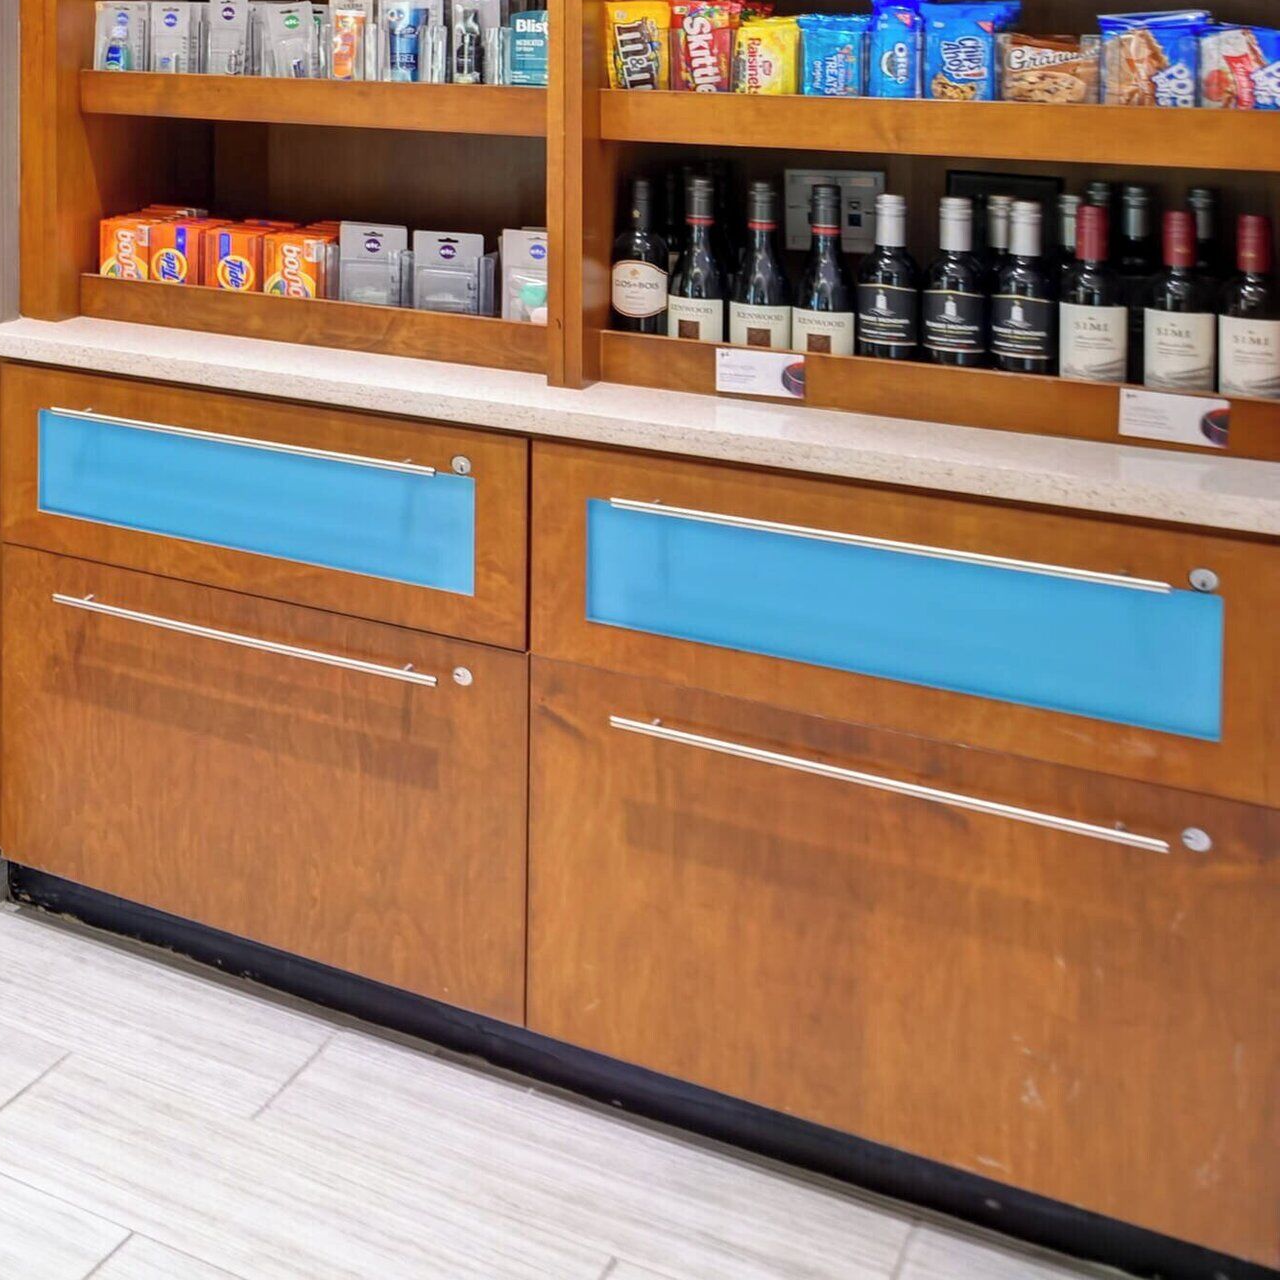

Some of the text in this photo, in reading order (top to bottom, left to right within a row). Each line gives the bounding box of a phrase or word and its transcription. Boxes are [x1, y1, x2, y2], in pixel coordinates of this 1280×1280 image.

[894, 42, 908, 84] OREO
[160, 252, 179, 281] Tide
[224, 259, 245, 289] Tide
[736, 310, 785, 322] KENWOOD
[797, 316, 846, 328] KENWOOD
[1073, 321, 1109, 332] SIMI
[1156, 327, 1192, 338] SIMI
[1233, 333, 1270, 345] SIMI
